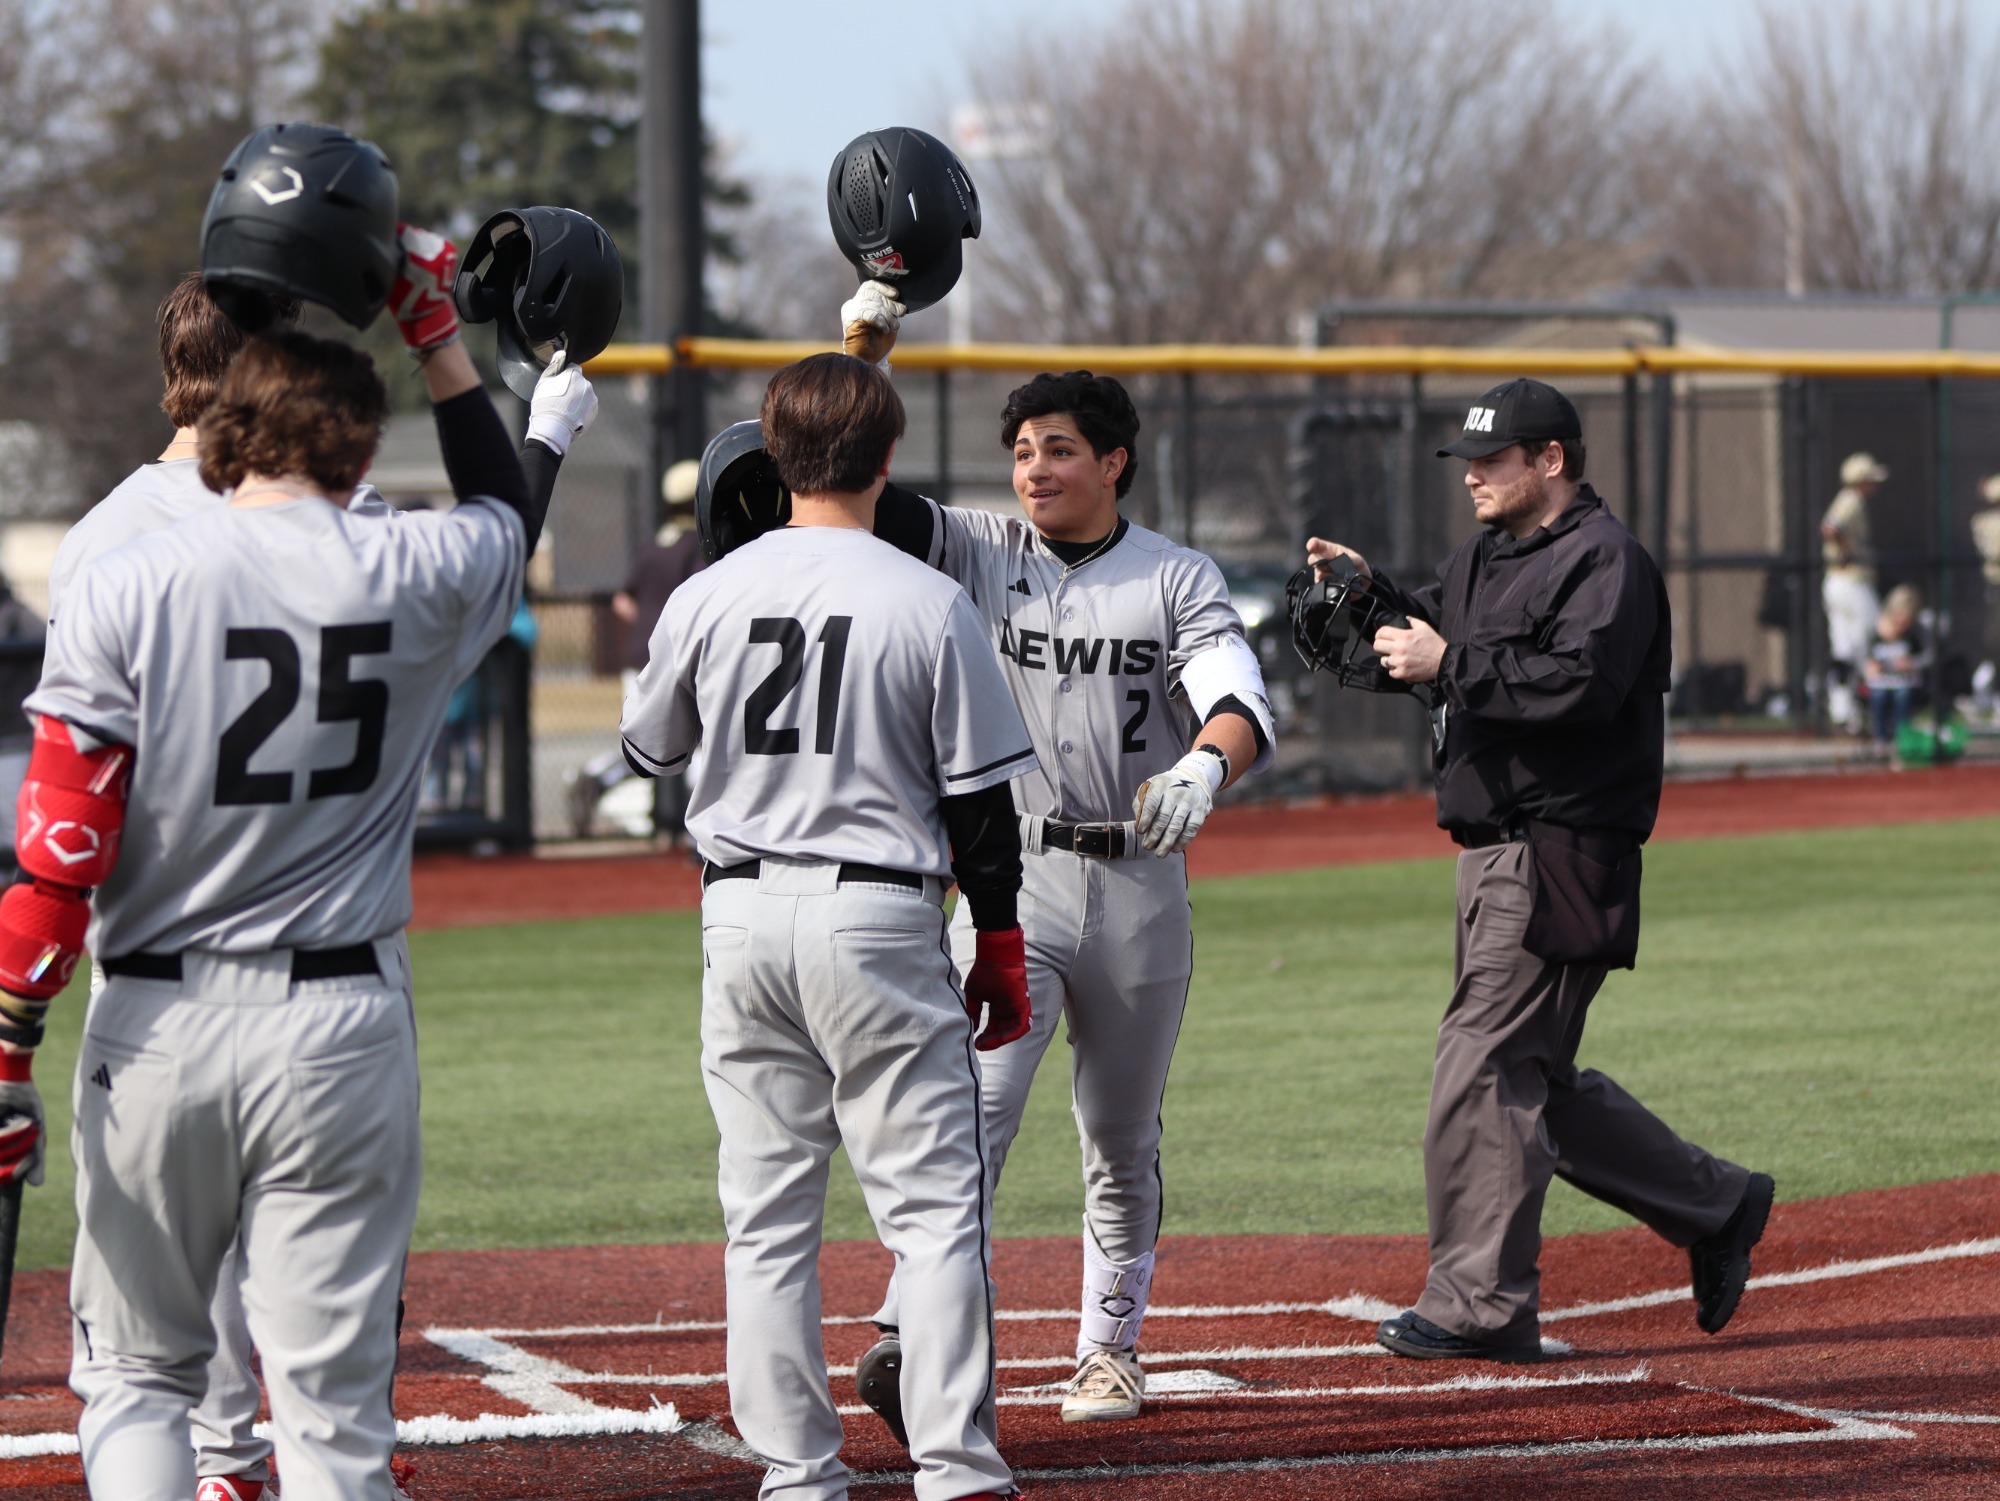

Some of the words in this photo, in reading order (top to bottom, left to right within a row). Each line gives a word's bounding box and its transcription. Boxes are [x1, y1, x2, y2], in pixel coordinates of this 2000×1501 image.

[860, 245, 894, 261] LEWIS
[1463, 406, 1495, 432] UA
[999, 615, 1160, 675] LEWIS
[214, 620, 393, 807] 25
[744, 617, 852, 755] 21
[1122, 689, 1150, 754] 2
